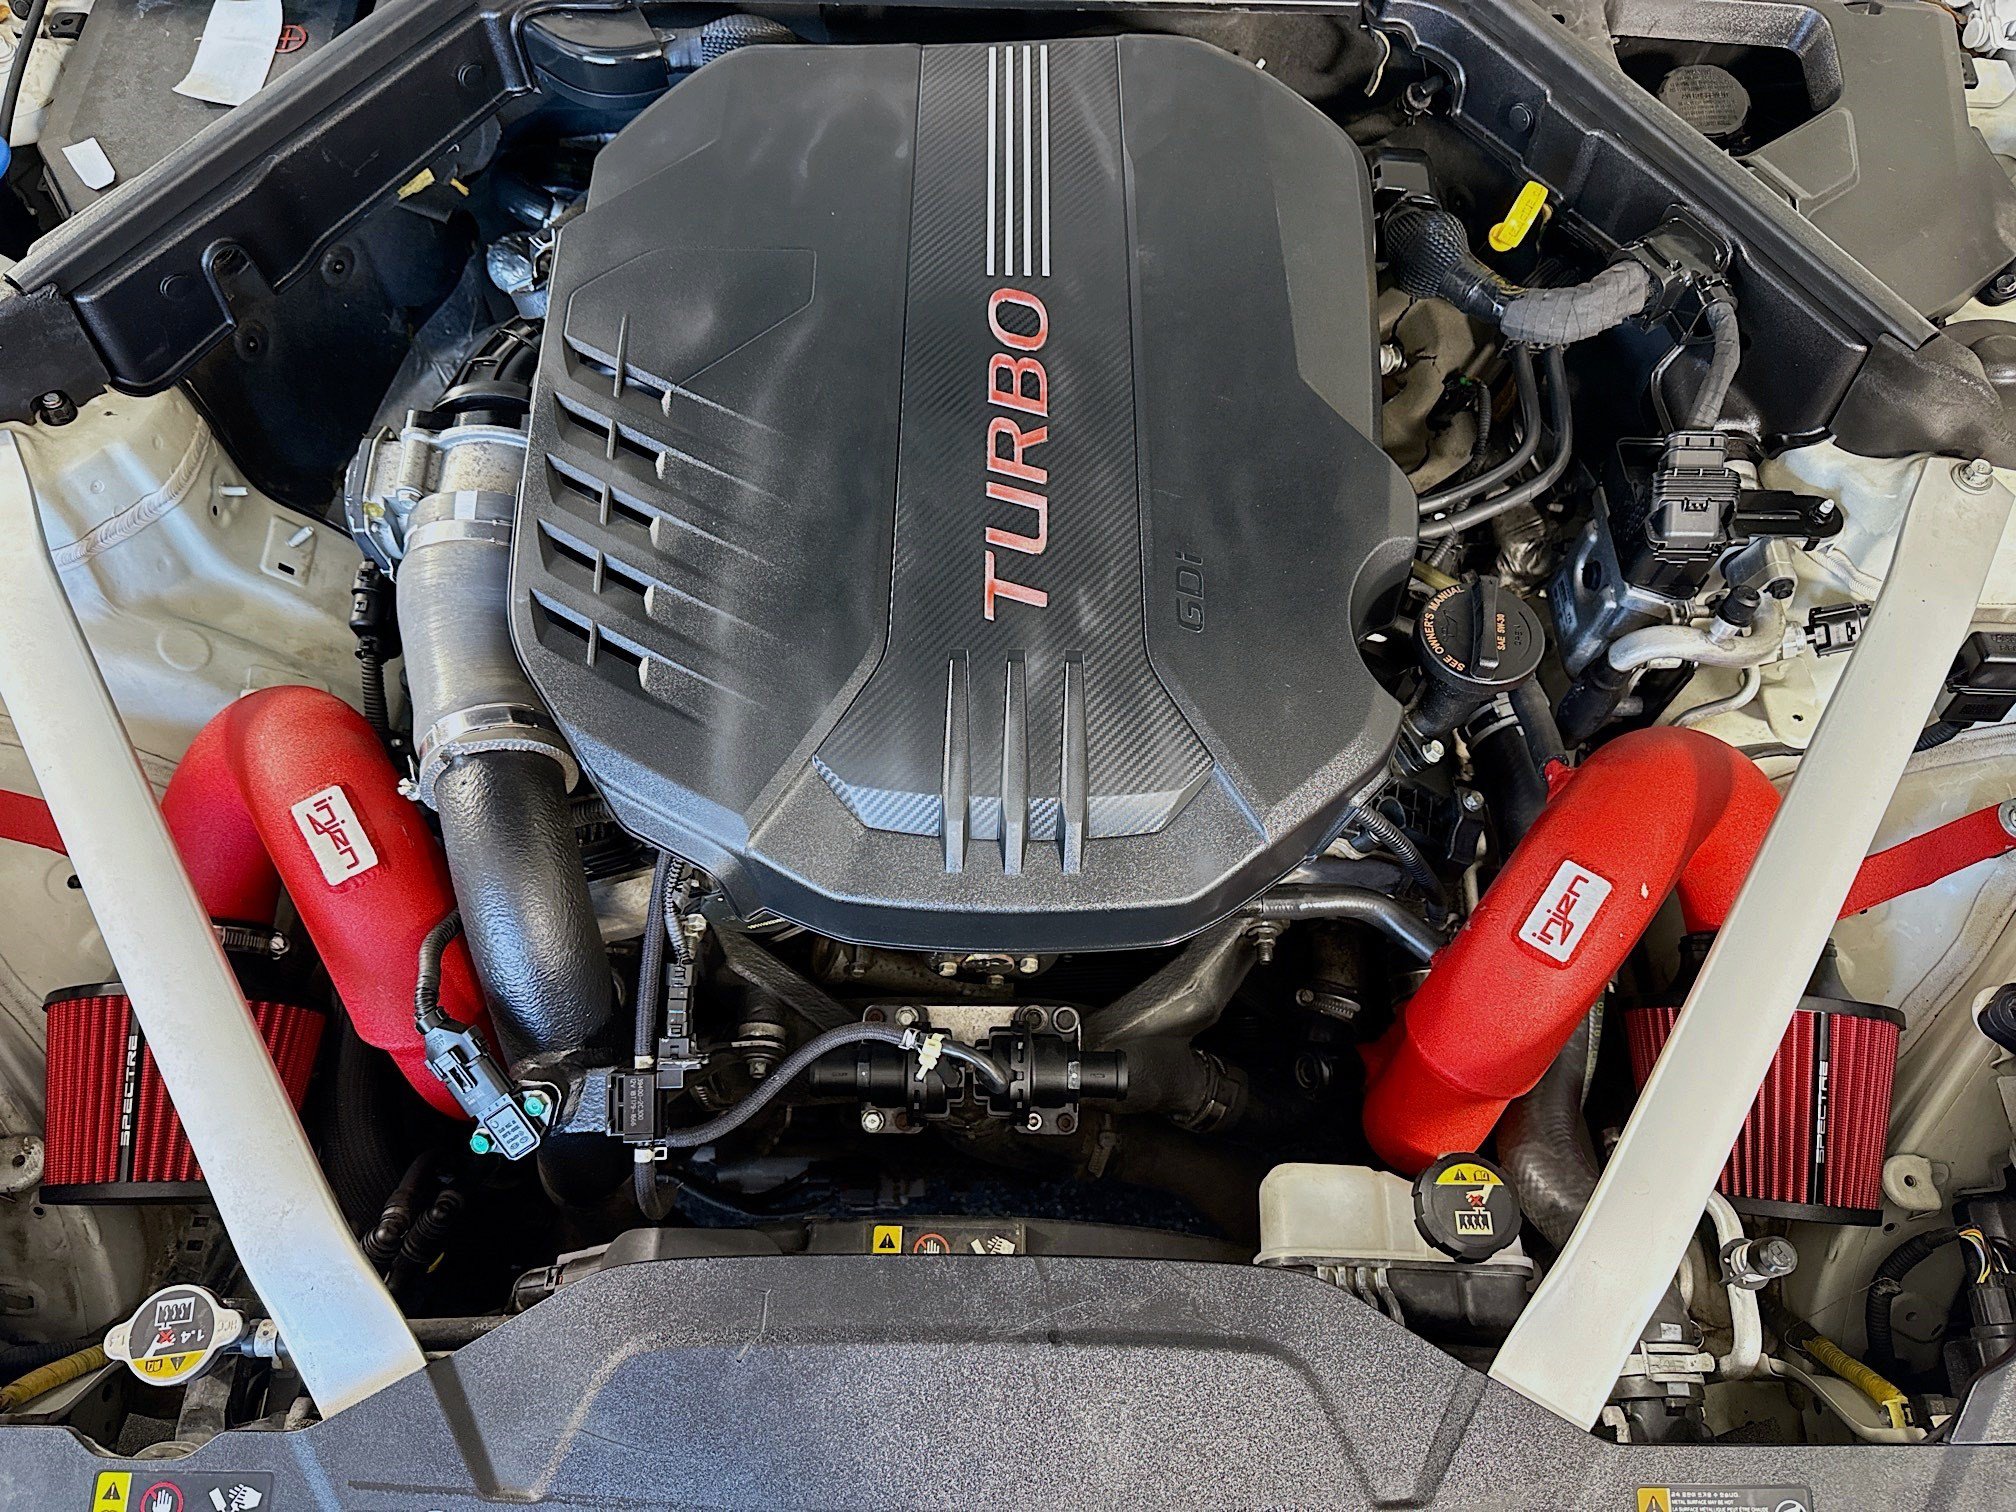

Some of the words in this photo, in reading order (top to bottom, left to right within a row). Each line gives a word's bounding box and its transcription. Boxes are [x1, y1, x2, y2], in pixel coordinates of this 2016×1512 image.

[983, 287, 1050, 622] TURBO
[1428, 585, 1466, 612] MANUAL
[1423, 612, 1445, 655] OWNER'S
[1497, 613, 1506, 634] 5W-30
[1497, 635, 1506, 651] SAE
[1443, 654, 1466, 672] SEE
[305, 795, 360, 870] injen
[1531, 874, 1590, 947] injen
[119, 1035, 139, 1147] SPECTRE
[1815, 1060, 1830, 1164] SPECTRE
[181, 1328, 205, 1344] 1.4
